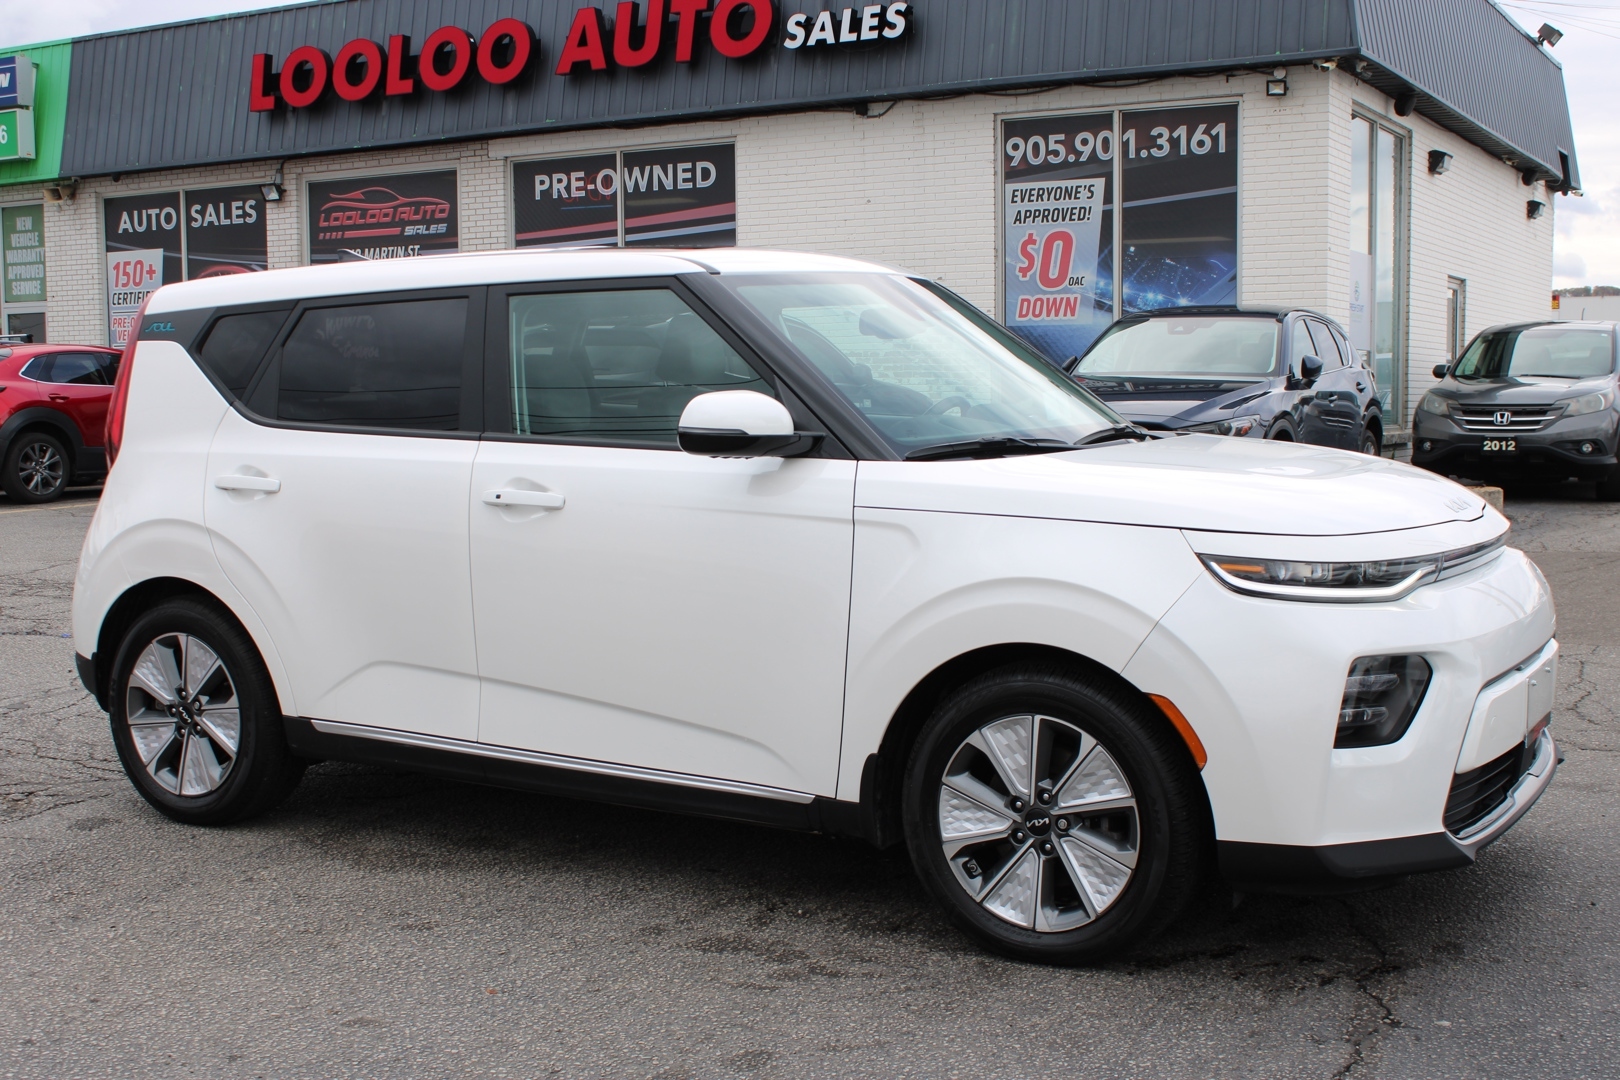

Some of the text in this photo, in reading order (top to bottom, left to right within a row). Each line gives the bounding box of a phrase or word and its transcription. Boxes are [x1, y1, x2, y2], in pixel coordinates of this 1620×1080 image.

[250, 0, 909, 112] LOOLOO AUTO SALES
[1005, 122, 1227, 167] 905.901.3161
[534, 161, 717, 200] PRE-OWNED
[1010, 184, 1095, 204] EVERYONE'S
[16, 216, 33, 231] NEW
[118, 200, 257, 234] AUTO SALES
[318, 204, 451, 228] LOOLOO AUTO
[1013, 206, 1092, 225] APPROVED!
[404, 223, 448, 236] SALES
[11, 232, 39, 247] VEHICLE
[6, 248, 45, 263] WARRANTY
[364, 246, 405, 261] MARTIN
[1018, 230, 1085, 289] $0 OAC
[8, 264, 44, 279] APPROVED
[112, 259, 157, 288] 150+
[12, 281, 41, 295] SERVICE
[112, 290, 154, 306] CERTIFI
[1017, 296, 1078, 319] DOWN
[1483, 440, 1516, 451] 2012
